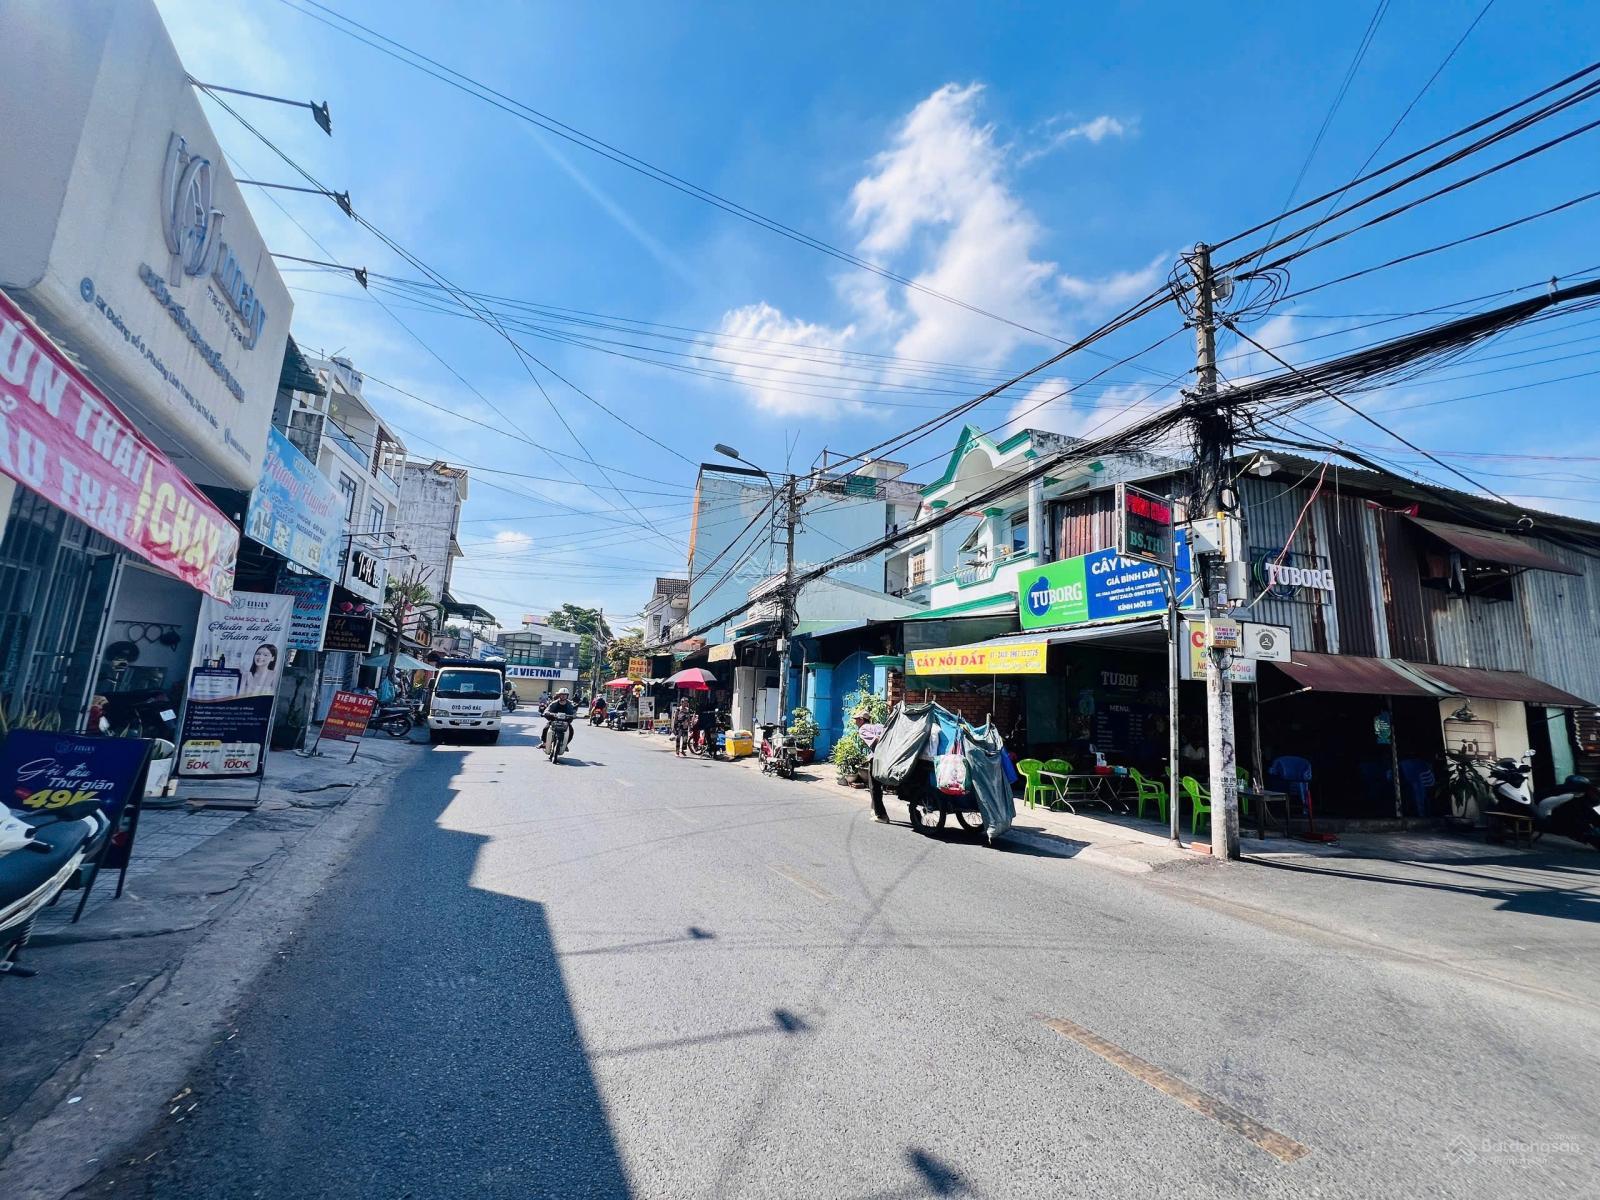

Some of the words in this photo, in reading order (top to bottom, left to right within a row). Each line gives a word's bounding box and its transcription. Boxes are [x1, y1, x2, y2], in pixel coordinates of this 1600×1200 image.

[1106, 574, 1120, 586] GIÁ
[1121, 571, 1141, 584] BÌNH
[1265, 562, 1335, 591] TUBORG
[1031, 582, 1083, 609] TUBORG
[960, 649, 986, 666] ĐẤT
[520, 667, 561, 679] VIETNAM
[186, 761, 210, 770] 50K
[224, 760, 250, 769] 100K
[48, 777, 77, 788] Thư
[79, 779, 115, 791] giãn
